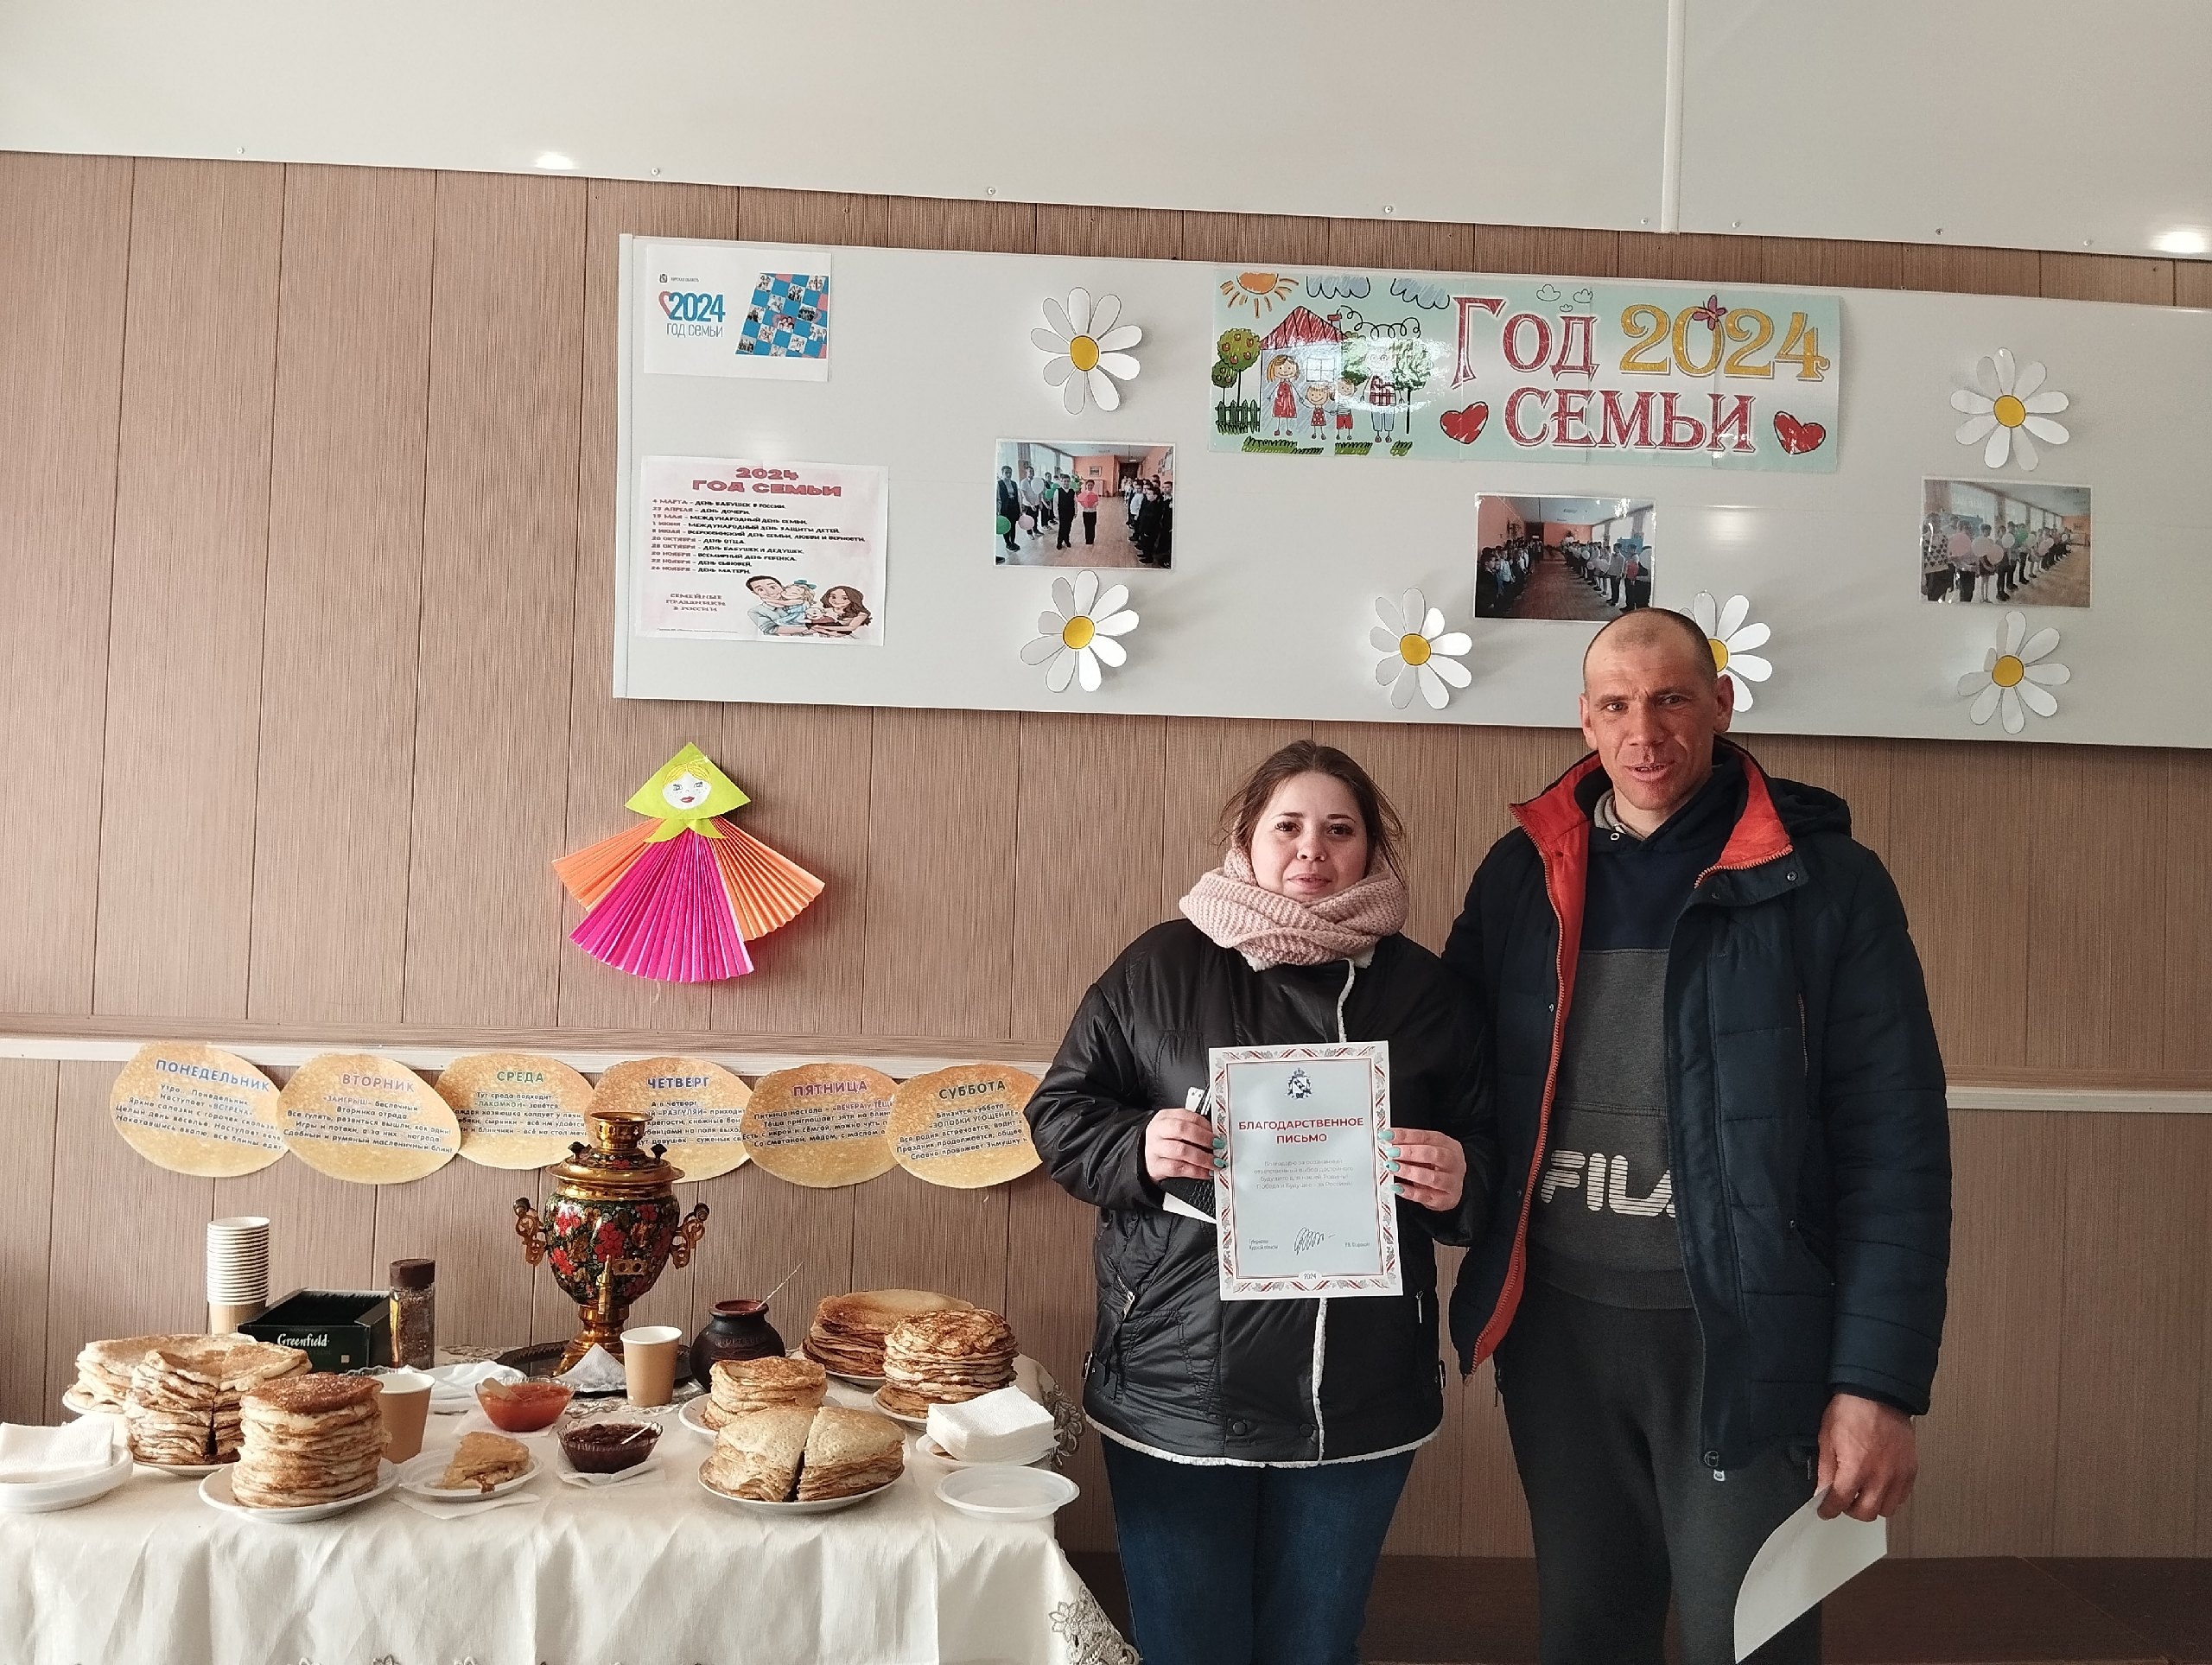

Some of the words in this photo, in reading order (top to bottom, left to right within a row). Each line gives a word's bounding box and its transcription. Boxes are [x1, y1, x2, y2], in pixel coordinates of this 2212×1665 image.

[669, 291, 726, 323] 2024
[1618, 302, 1833, 383] 2024
[1500, 387, 1756, 455] СЕМЬИ
[735, 467, 799, 481] 2024
[692, 480, 745, 493] ГОД
[752, 483, 842, 497] СЕМЬИ
[156, 1059, 270, 1092] ПОНЕДЕЛЬНИК
[342, 1073, 415, 1093] ВТОРНИК
[496, 1071, 544, 1084] СРЕДА
[647, 1077, 709, 1089] ЧЕТВЕРГ
[792, 1080, 868, 1097] ПЯТНИЦА
[938, 1080, 1006, 1100] СУББОТА
[160, 1093, 207, 1108] Наступает
[516, 1093, 553, 1102] подходит
[666, 1100, 697, 1109] четверг
[129, 1096, 155, 1107] Яркие
[157, 1103, 193, 1115] салазки
[204, 1111, 238, 1122] горочек
[336, 1105, 376, 1116] Вторника
[753, 1111, 787, 1121] Пятница
[790, 1107, 823, 1117] настала
[936, 1107, 972, 1119] Близится
[974, 1103, 1004, 1115] суббота
[115, 1103, 145, 1115] Целый
[149, 1112, 169, 1121] день
[214, 1122, 260, 1136] Наступает
[287, 1109, 302, 1118] Все
[415, 1124, 429, 1133] как
[296, 1121, 318, 1130] Игры
[485, 1118, 518, 1127] сырники
[648, 1119, 686, 1128] крепости,
[688, 1117, 724, 1126] снежные
[763, 1120, 785, 1128] Тёща
[787, 1115, 836, 1127] приглашает
[837, 1113, 855, 1122] зятя
[1238, 1117, 1364, 1131] БЛАГОДАРСТВЕННОЕ
[116, 1115, 176, 1132] Накатавшись
[232, 1135, 259, 1146] блины
[478, 1126, 514, 1134] блинчики
[697, 1126, 717, 1134] поля
[742, 1133, 759, 1141] Есть
[768, 1128, 792, 1139] икрой
[834, 1122, 861, 1131] можно
[766, 1134, 806, 1146] сметаной,
[847, 1128, 879, 1139] маслом
[915, 1133, 939, 1143] родня
[994, 1120, 1016, 1128] водит
[283, 1128, 321, 1140] Сдобный
[332, 1135, 371, 1145] румяный
[372, 1139, 429, 1151] масленичный
[652, 1137, 688, 1147] девушек
[696, 1135, 731, 1146] суженых
[1276, 1133, 1327, 1145] ПИСЬМО
[896, 1141, 935, 1154] Праздник
[910, 1151, 939, 1161] Славно
[942, 1143, 984, 1156] провожает
[986, 1138, 1021, 1150] Зимушку
[276, 1332, 328, 1348] Greenfield
